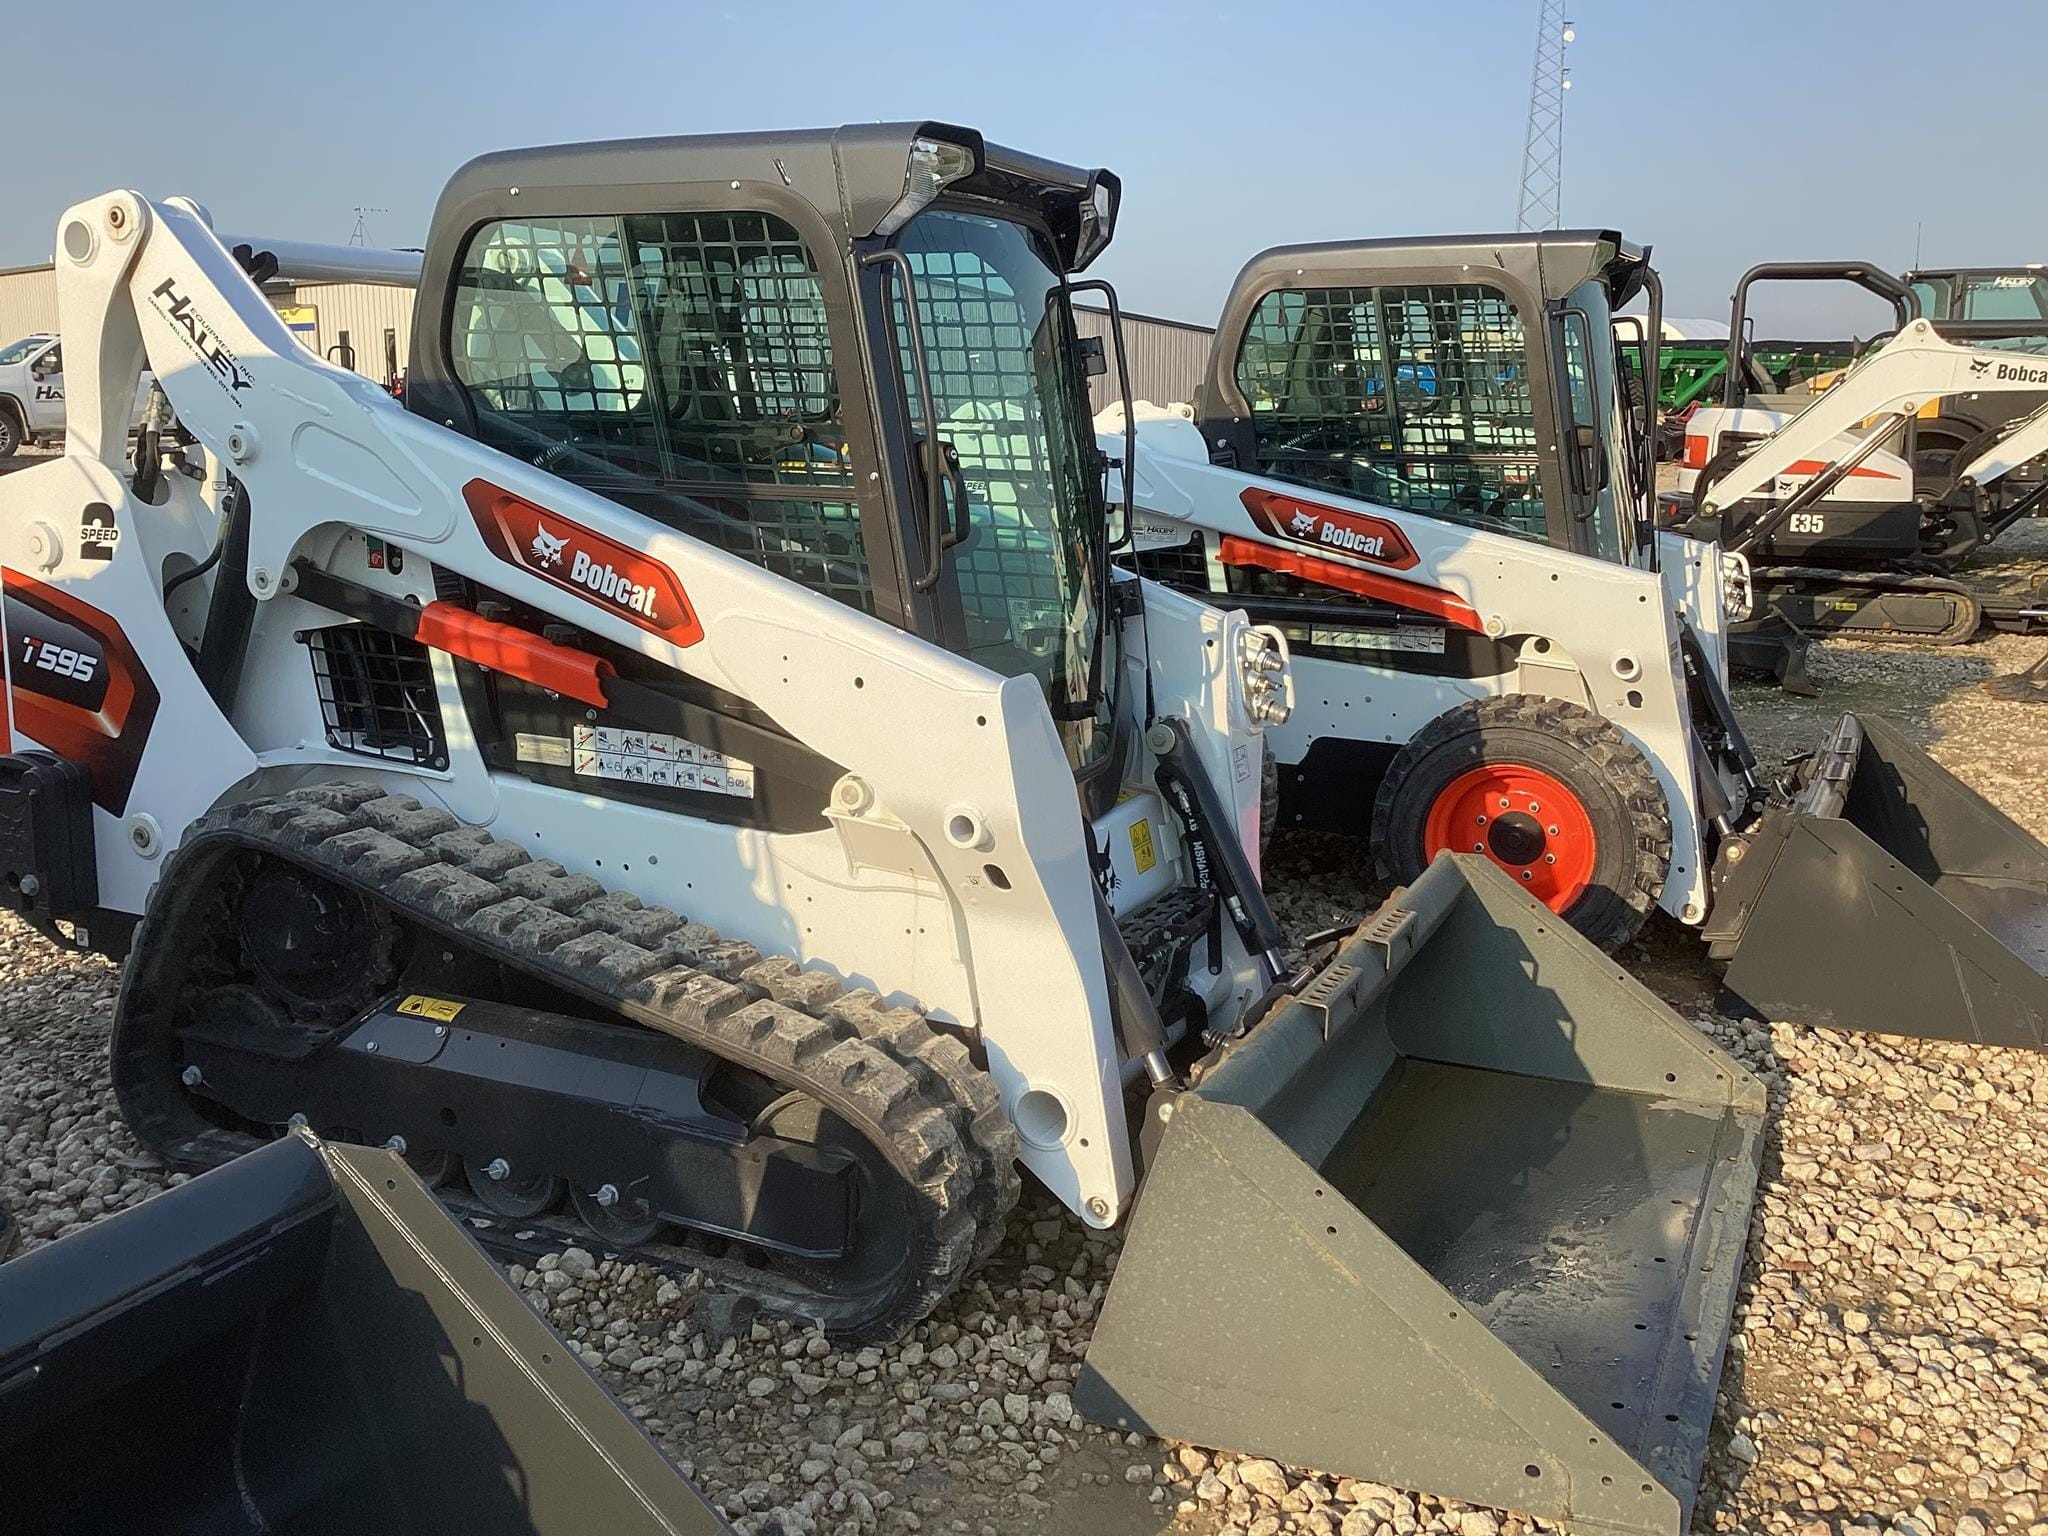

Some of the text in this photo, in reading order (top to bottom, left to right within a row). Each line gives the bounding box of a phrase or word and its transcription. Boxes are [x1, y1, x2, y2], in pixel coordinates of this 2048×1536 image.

[152, 277, 252, 391] HALEY
[190, 307, 257, 386] EQUIPMENT INC.
[81, 528, 119, 541] SPEED
[1320, 521, 1384, 557] Bobcat
[1789, 513, 1825, 533] E35
[570, 549, 657, 618] Bobcat
